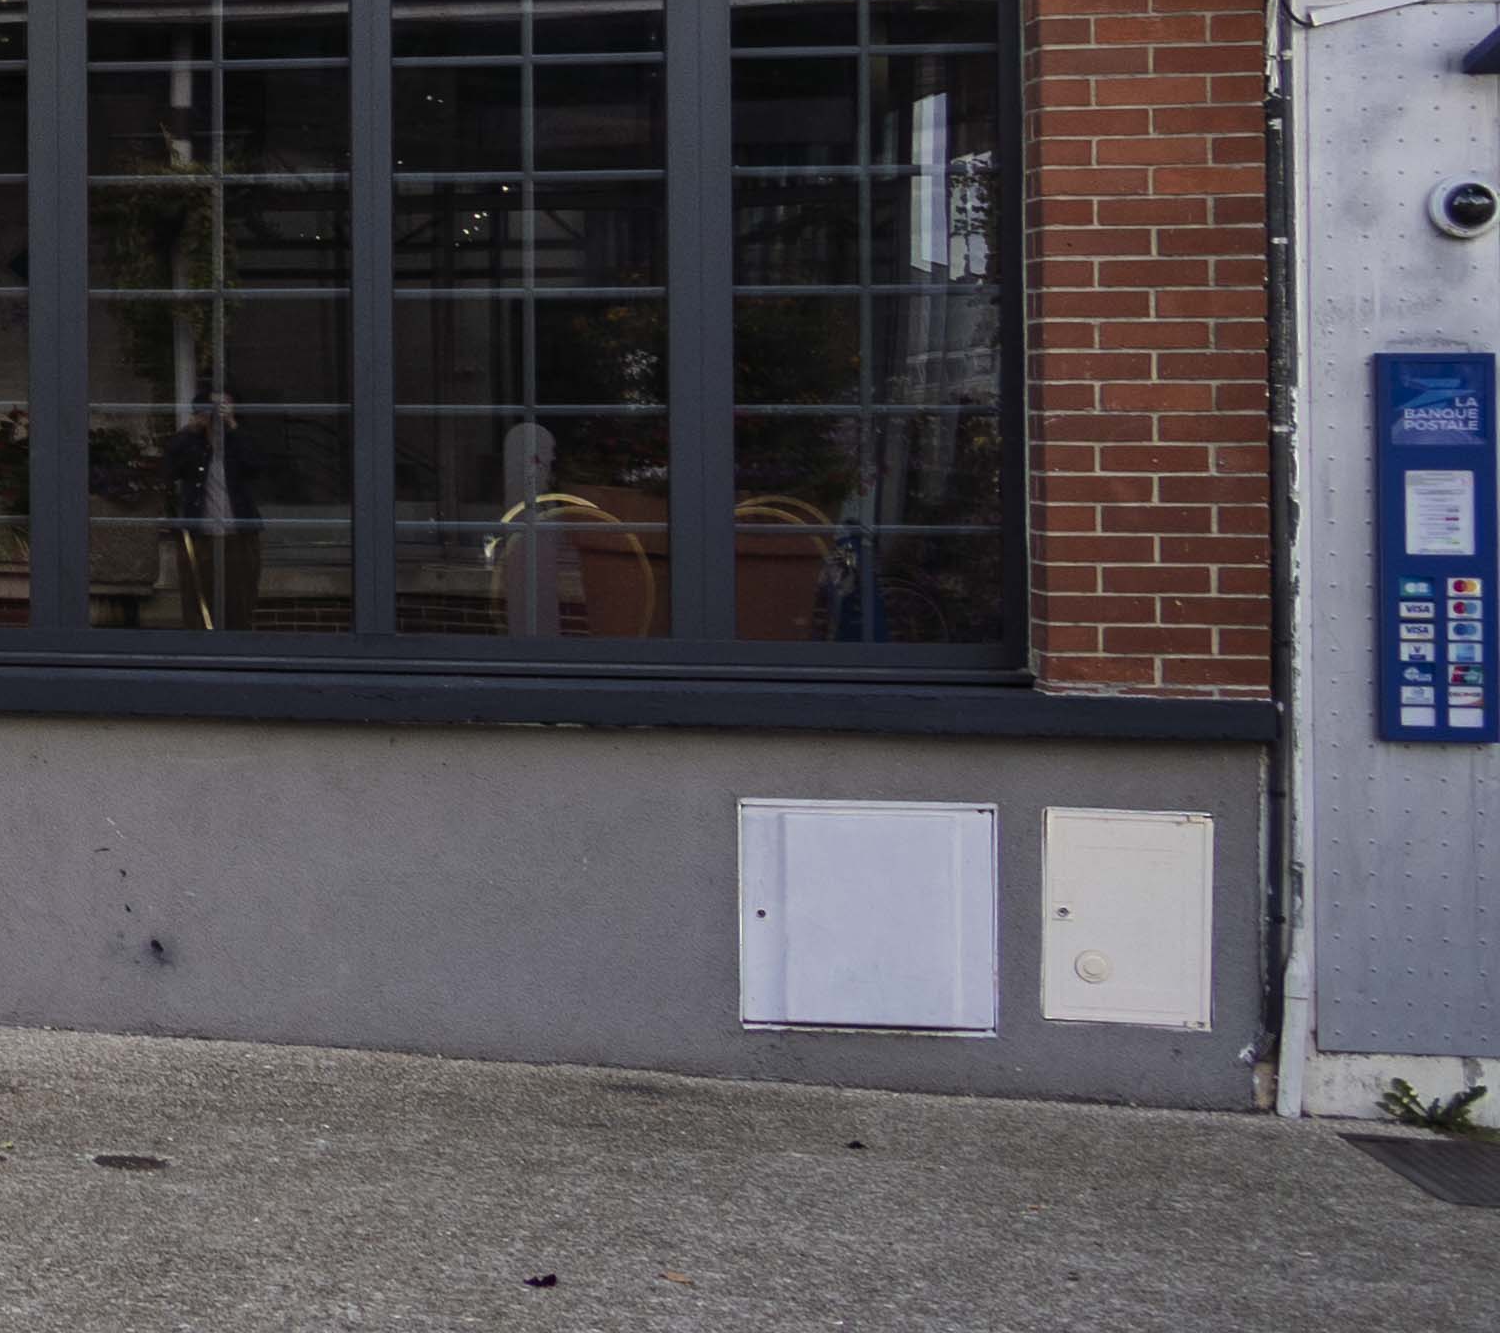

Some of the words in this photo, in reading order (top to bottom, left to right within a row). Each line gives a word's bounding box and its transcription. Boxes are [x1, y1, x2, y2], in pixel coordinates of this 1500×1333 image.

[1454, 396, 1479, 407] LA
[1404, 408, 1479, 419] BANQUE
[1404, 419, 1479, 431] POSTALE
